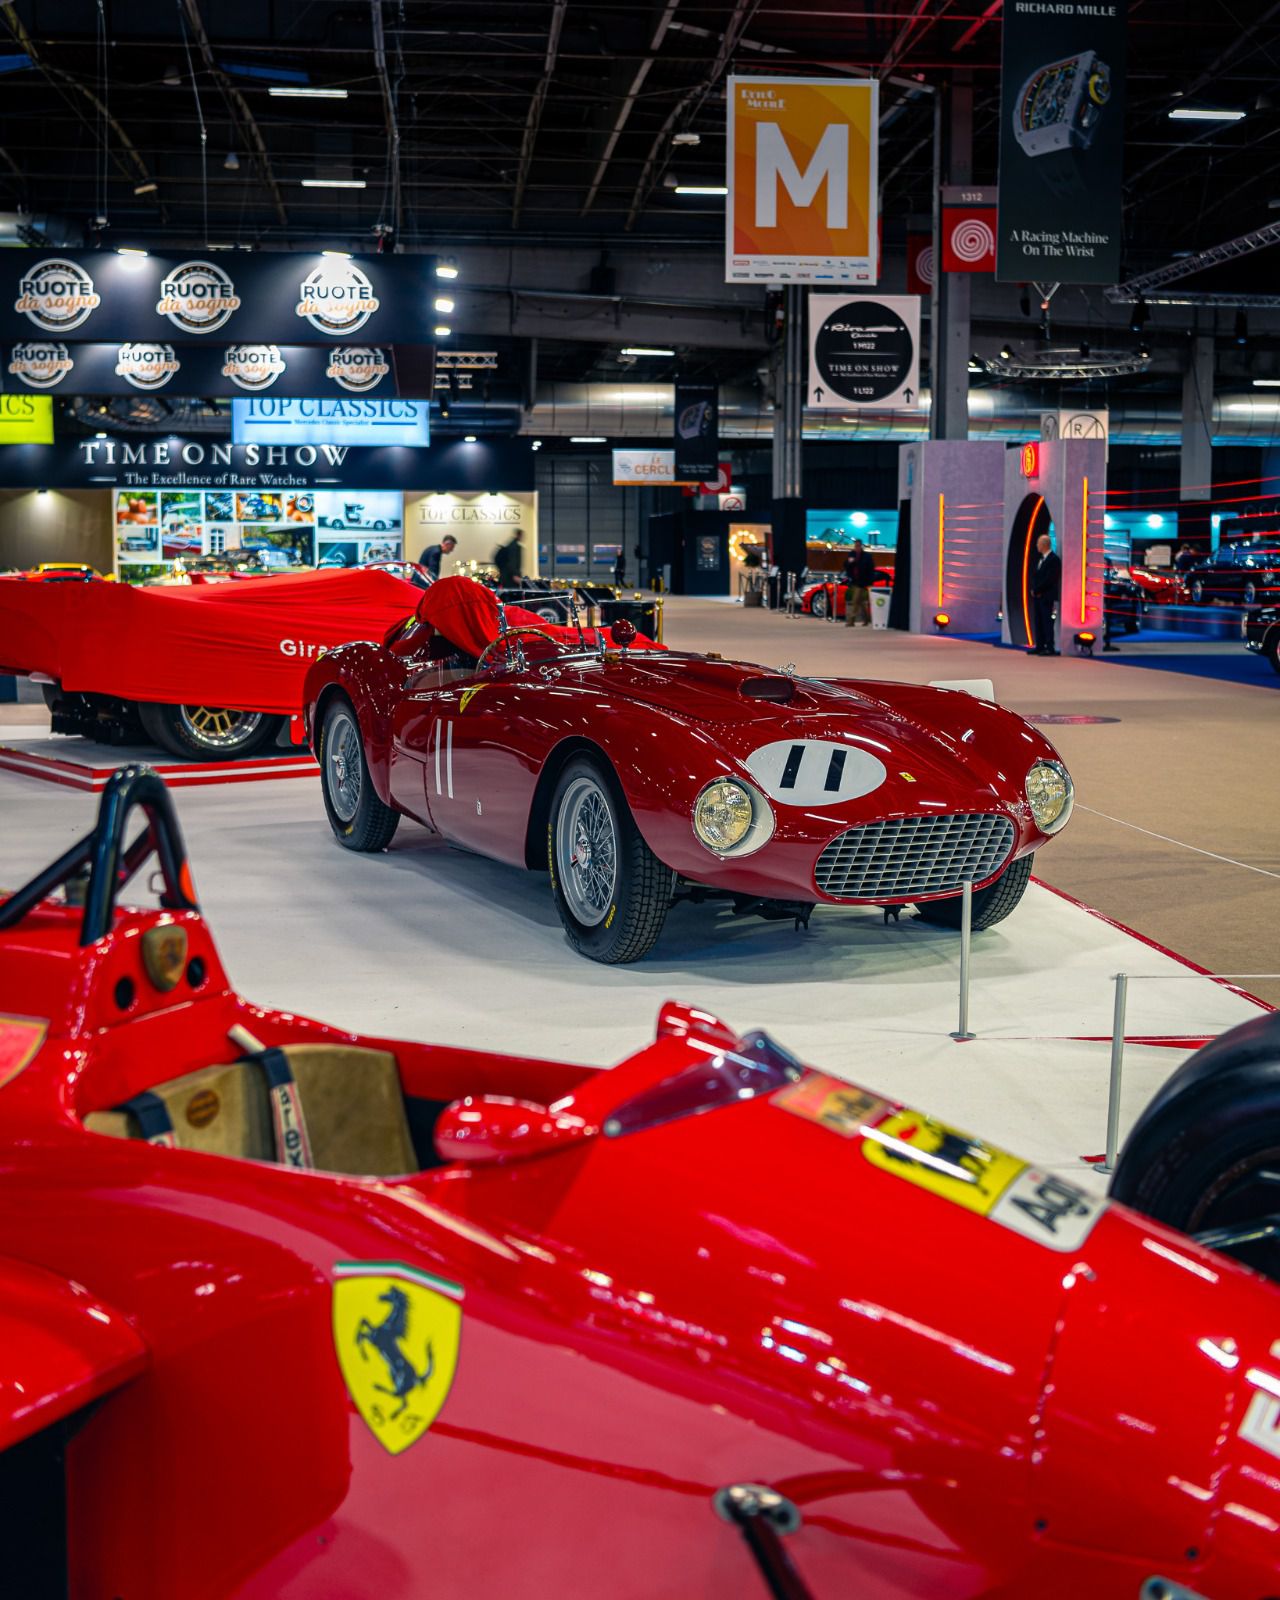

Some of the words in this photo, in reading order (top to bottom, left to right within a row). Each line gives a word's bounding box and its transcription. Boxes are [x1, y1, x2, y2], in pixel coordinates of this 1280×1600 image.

[1015, 2, 1074, 15] RICHARD
[1076, 5, 1117, 16] MILLE
[755, 122, 849, 229] M
[961, 193, 983, 202] 1312
[1010, 230, 1020, 242] A
[1021, 231, 1060, 245] Racing
[1062, 231, 1109, 245] Machine
[1022, 244, 1040, 256] On
[1041, 245, 1063, 257] The
[1064, 246, 1096, 258] Wrist
[22, 281, 91, 296] RUOTE
[164, 283, 232, 298] RUOTE
[304, 286, 371, 300] RUOTE
[17, 294, 39, 310] da
[45, 295, 98, 312] sogno
[159, 297, 181, 312] da
[187, 297, 239, 315] sogno
[299, 300, 319, 315] da
[14, 350, 66, 361] RUOTE
[122, 352, 173, 363] RUOTE
[227, 353, 278, 364] RUOTE
[332, 354, 383, 366] RUOTE
[31, 359, 72, 376] sogno
[349, 362, 389, 378] sogno
[828, 364, 852, 372] TIME
[854, 364, 869, 372] ON
[871, 364, 900, 373] SHOW
[248, 398, 292, 417] TOP
[299, 398, 418, 418] CLASSICS
[1074, 423, 1083, 436] R
[79, 441, 171, 465] TIME
[181, 441, 233, 465] ON
[245, 443, 351, 467] SHOW
[124, 472, 149, 485] The
[151, 472, 212, 485] Excellence
[214, 472, 229, 485] of
[230, 473, 256, 486] Rare
[258, 473, 308, 486] Watches
[451, 507, 521, 521] CLASSICS
[434, 718, 454, 799] 11
[779, 744, 848, 792] 11
